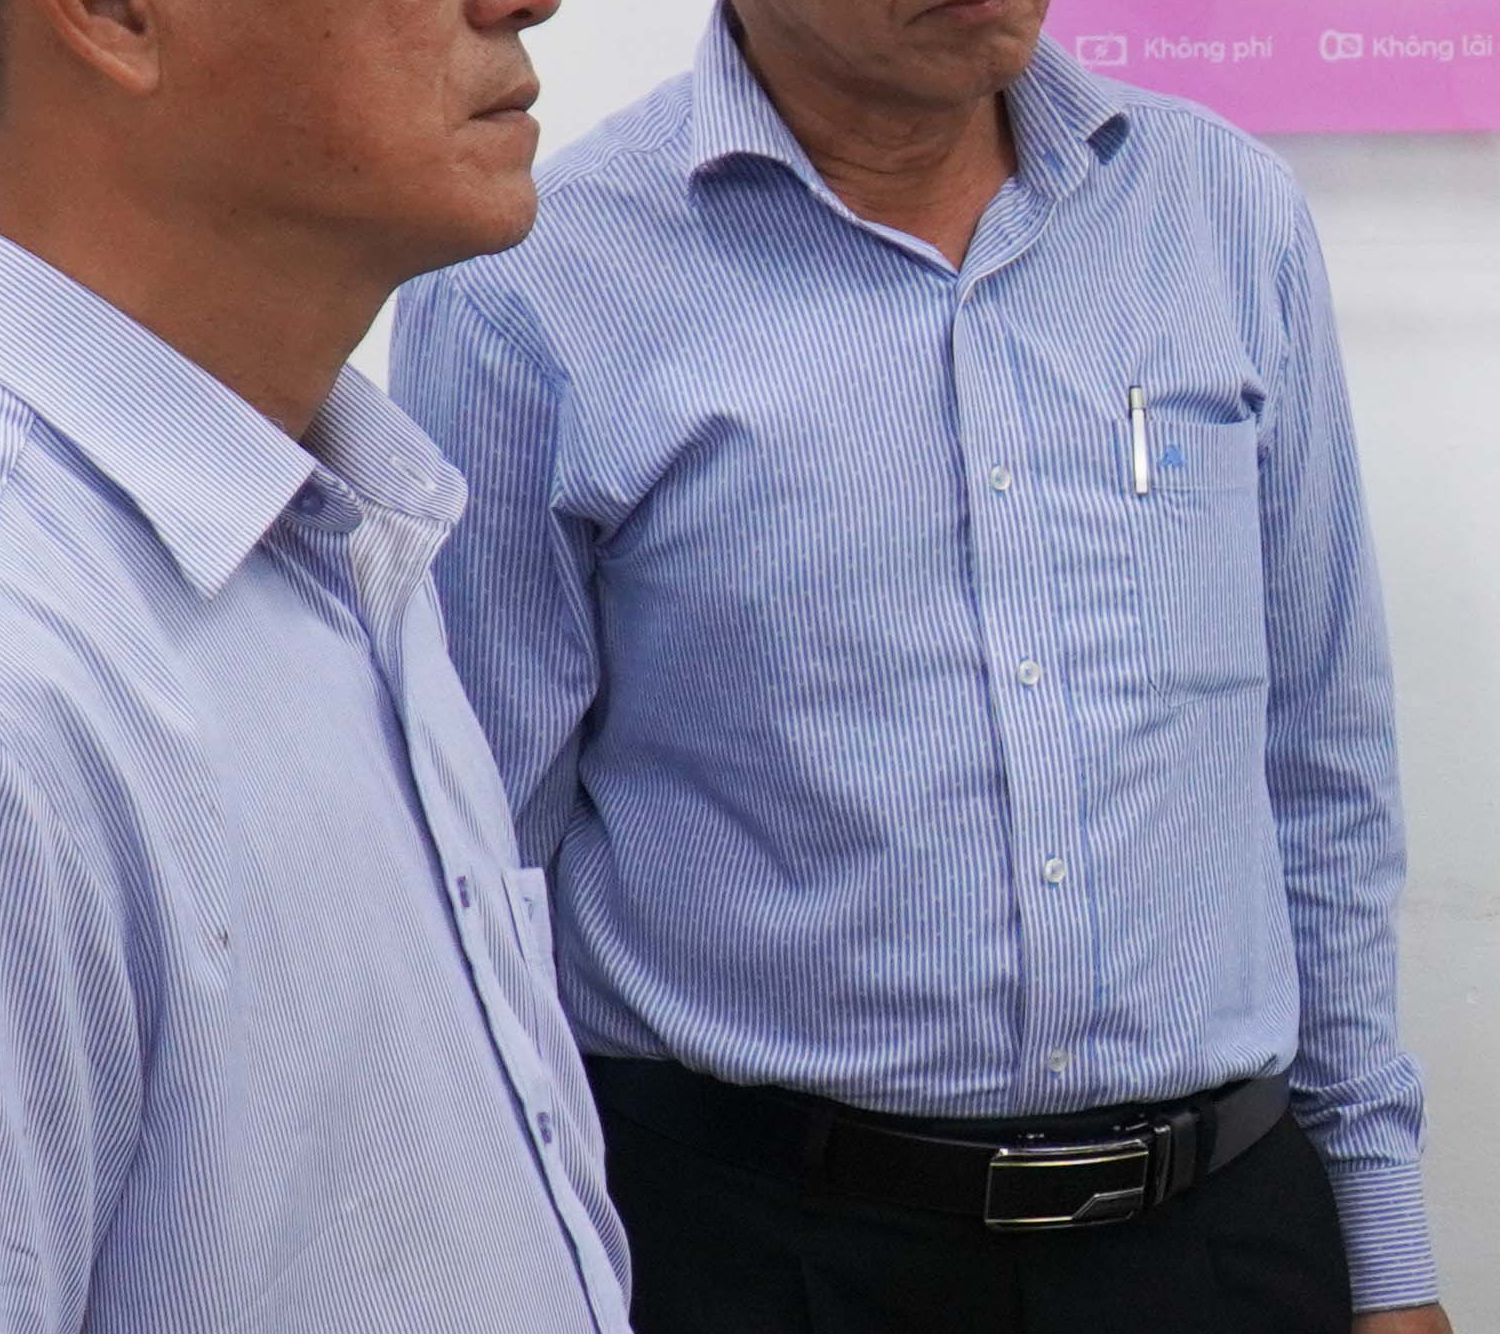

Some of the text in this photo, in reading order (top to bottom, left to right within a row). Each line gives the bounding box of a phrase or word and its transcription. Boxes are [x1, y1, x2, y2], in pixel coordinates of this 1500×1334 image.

[1144, 34, 1274, 63] Không phí
[1371, 33, 1455, 62] Không
[1461, 33, 1493, 58] lãi
